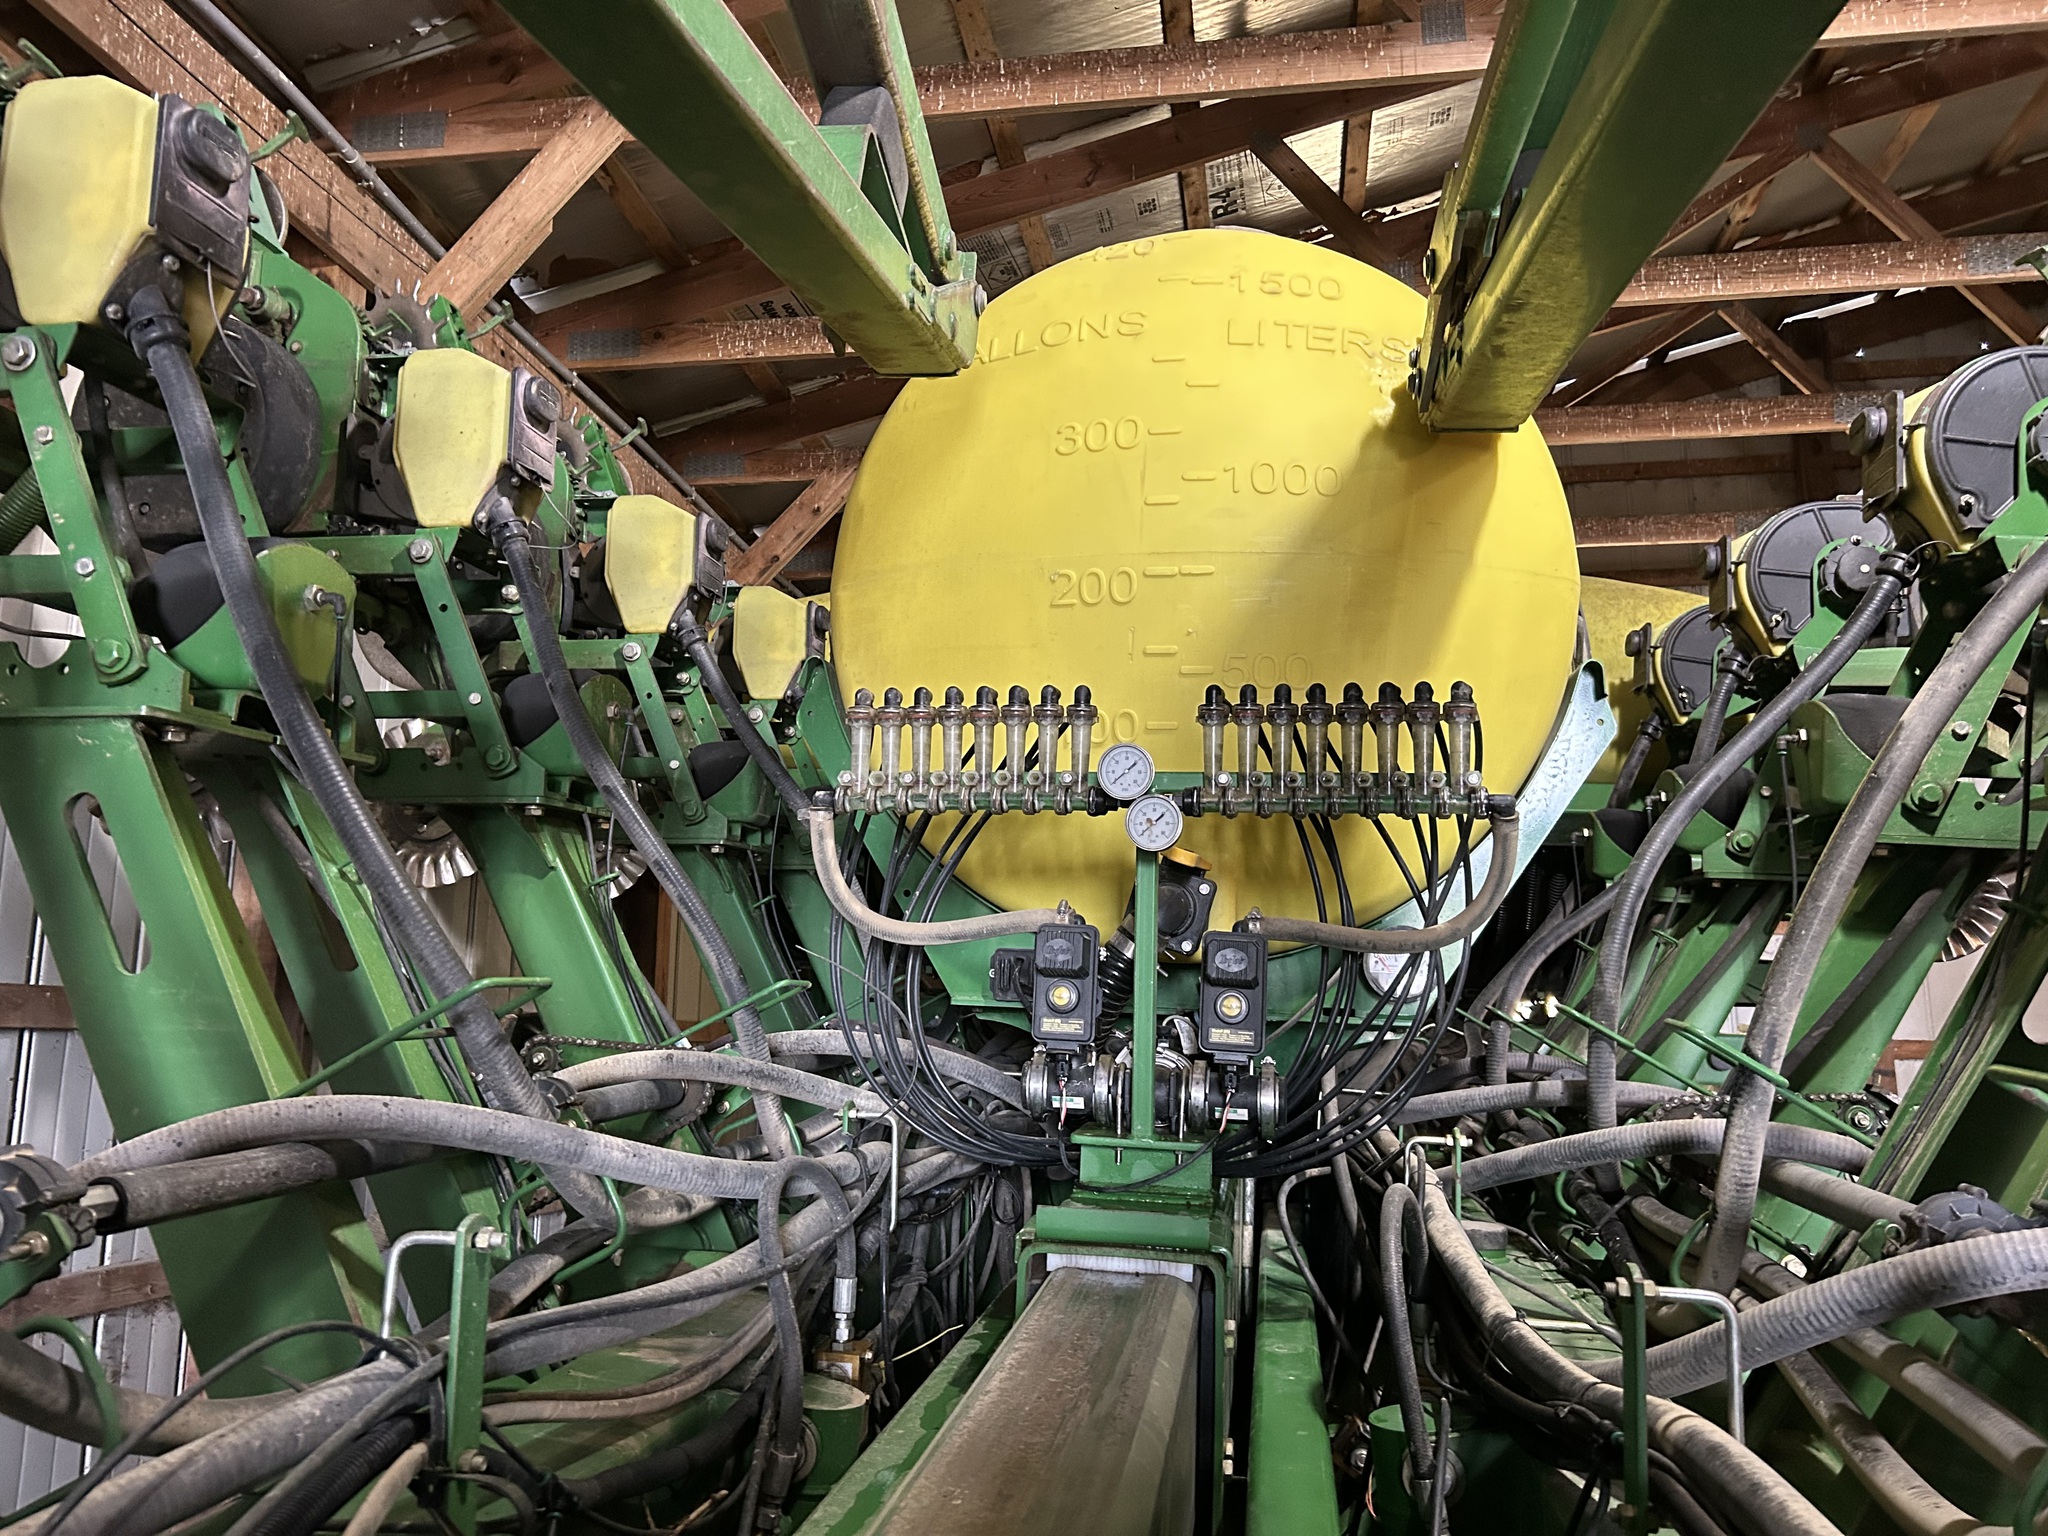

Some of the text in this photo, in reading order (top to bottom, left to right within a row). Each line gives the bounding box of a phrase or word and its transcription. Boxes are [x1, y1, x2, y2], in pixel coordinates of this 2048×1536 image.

[1229, 271, 1345, 301] 1500
[974, 310, 1148, 365] ALLONS
[1226, 318, 1413, 363] LITERS
[1054, 414, 1145, 457] 300
[1222, 460, 1343, 497] 1000
[1048, 565, 1139, 608] 200
[1221, 652, 1313, 690] 500
